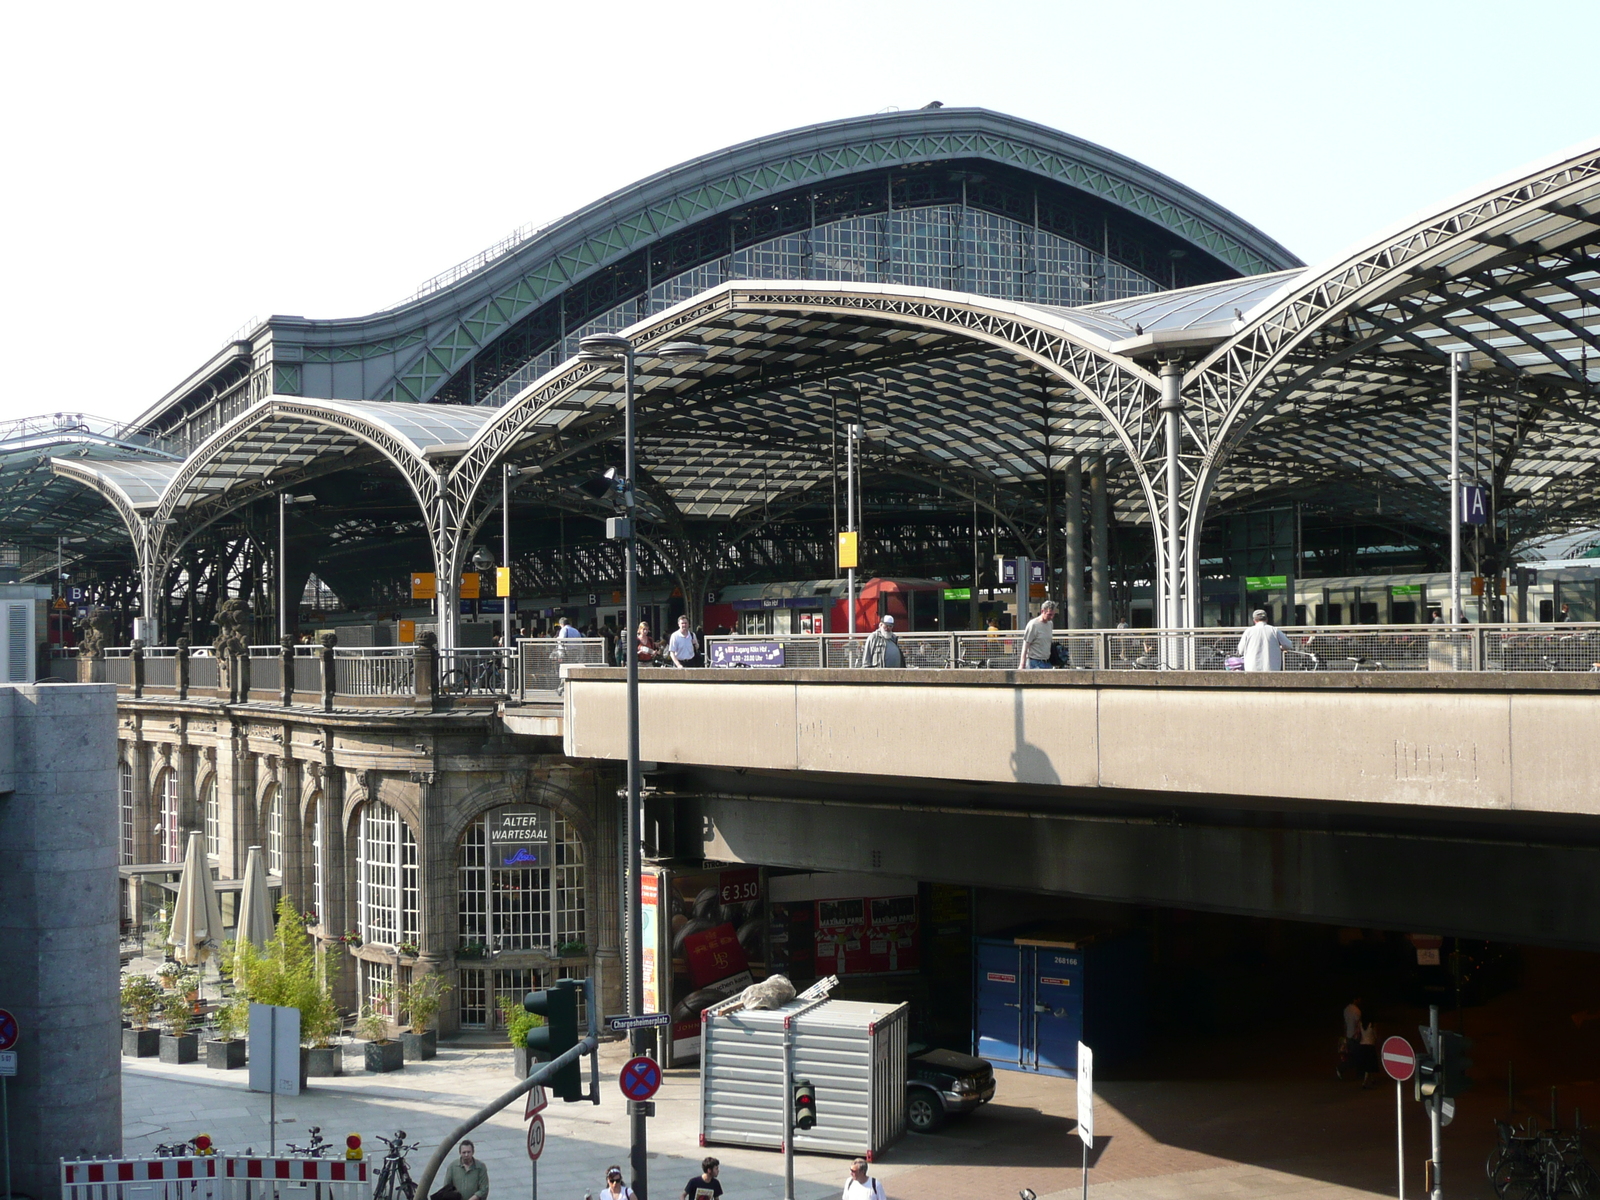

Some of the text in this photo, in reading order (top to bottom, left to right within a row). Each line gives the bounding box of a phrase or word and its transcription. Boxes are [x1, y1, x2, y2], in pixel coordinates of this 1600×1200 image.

[1472, 488, 1484, 515] A
[72, 587, 81, 600] B
[588, 593, 597, 605] B
[708, 592, 716, 603] B
[734, 646, 750, 654] Zugang
[502, 816, 537, 827] ALTER
[492, 829, 548, 840] WARTESAAL
[721, 882, 758, 901] € 3.50
[846, 916, 864, 925] PARK
[898, 914, 916, 923] PARK
[1054, 956, 1078, 966] 268166
[714, 974, 750, 991] uchen kann
[613, 1016, 668, 1029] Chargesheimerplatz
[677, 1022, 700, 1032] JOHN
[530, 1125, 541, 1148] 40
